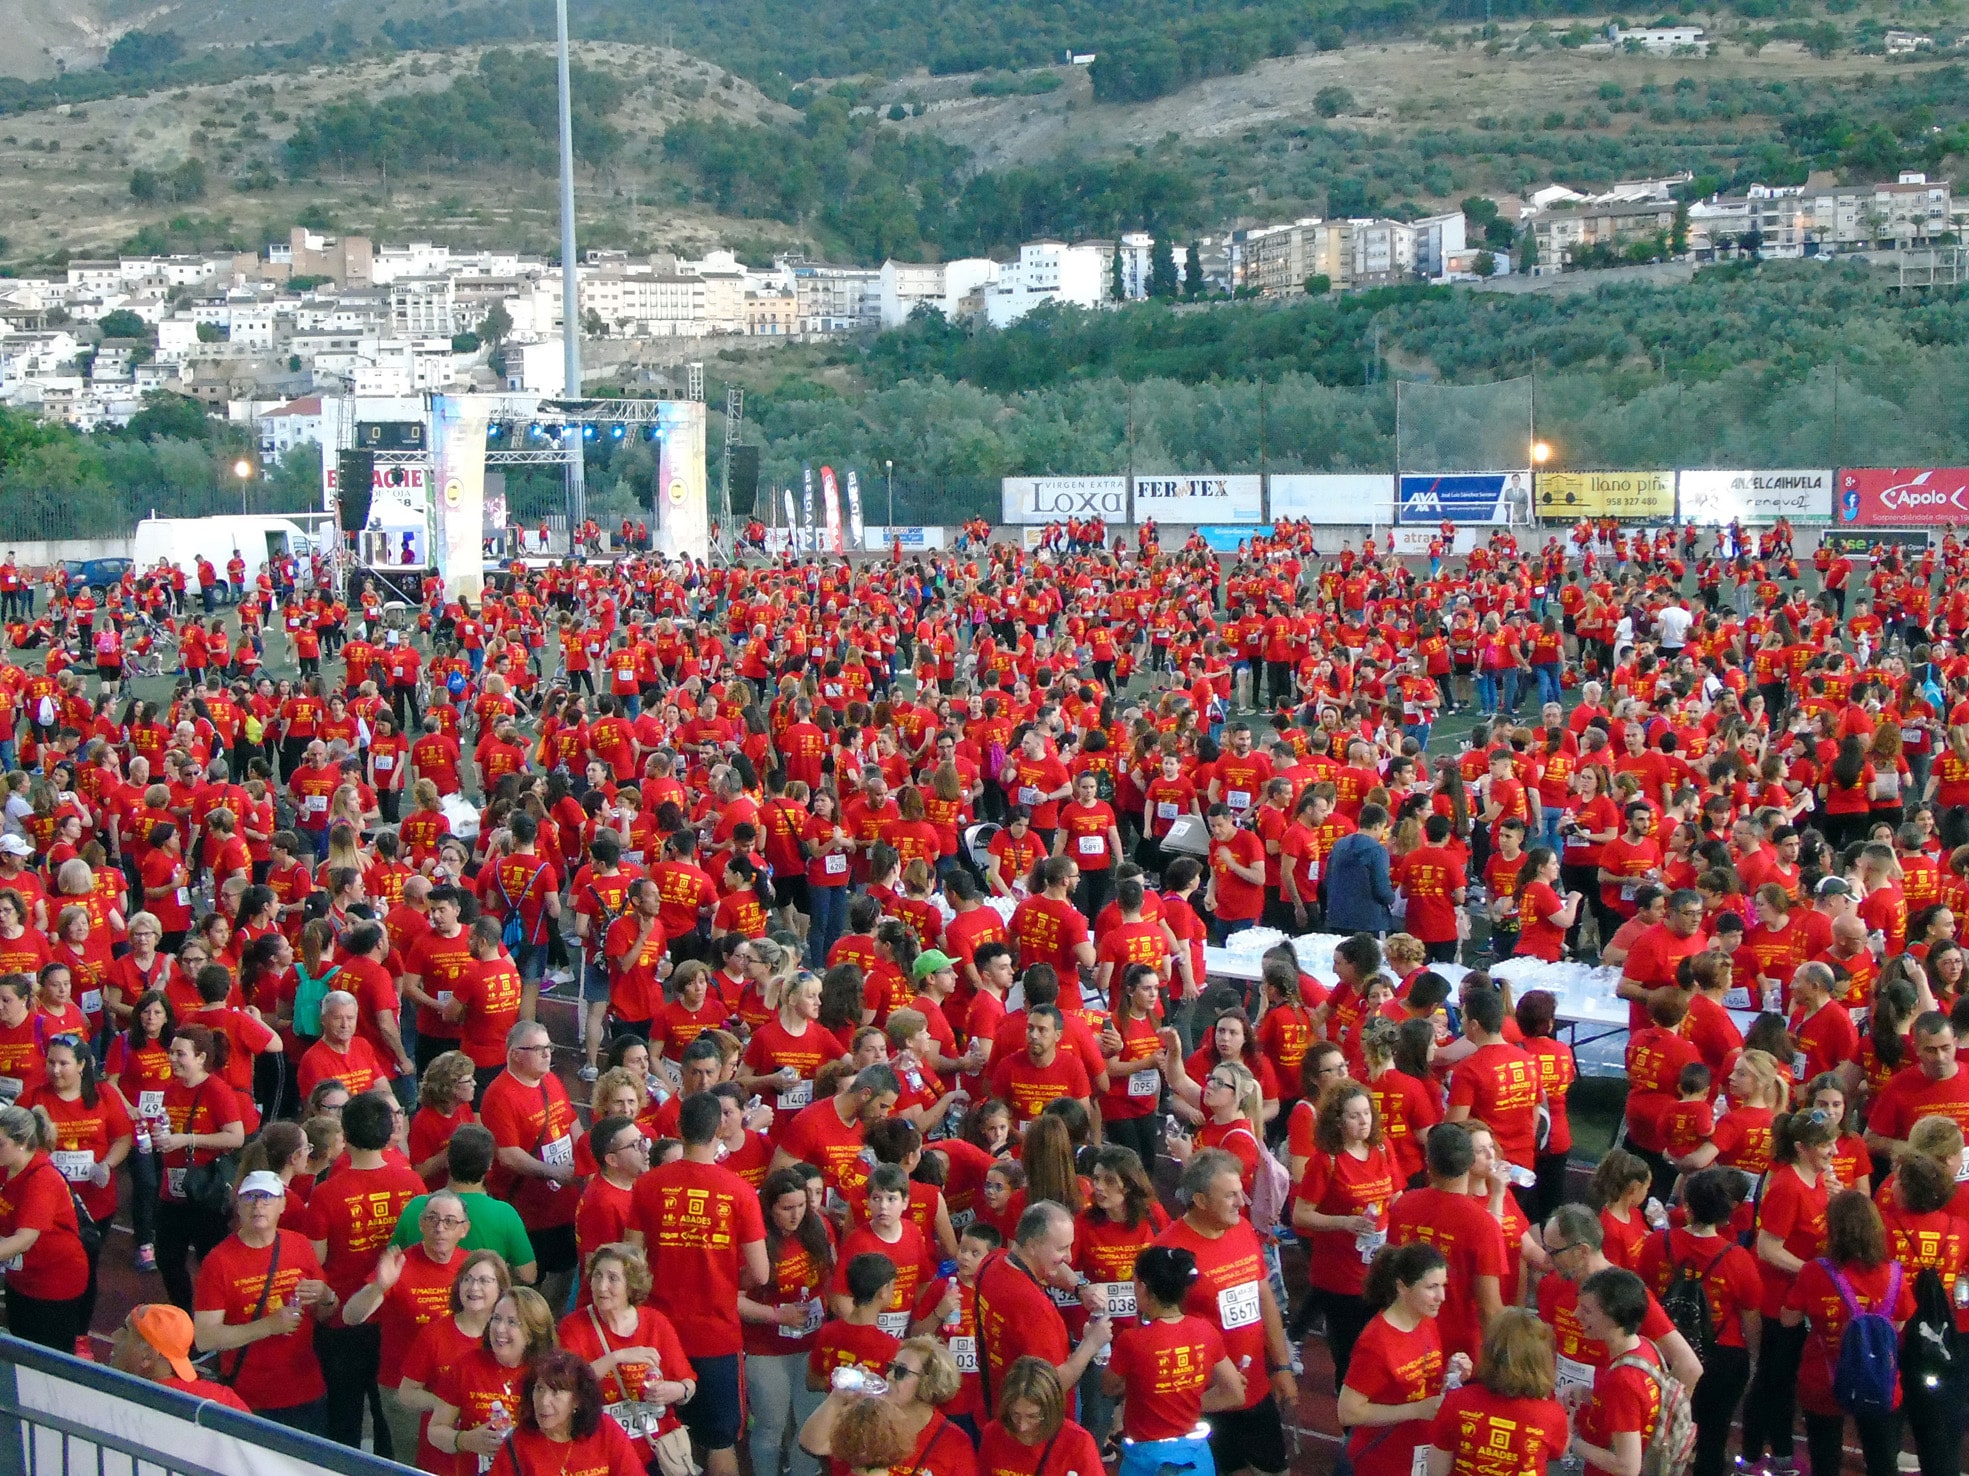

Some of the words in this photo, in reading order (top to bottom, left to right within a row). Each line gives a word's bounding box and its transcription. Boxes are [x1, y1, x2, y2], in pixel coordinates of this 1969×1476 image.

[1045, 481, 1085, 489] VIRGEN
[1591, 477, 1631, 491] llano
[1403, 492, 1442, 512] AXA
[1897, 490, 1946, 507] Apolo
[144, 1103, 159, 1114] 49
[367, 1215, 399, 1227] ABADES
[680, 1215, 712, 1225] ABADES
[1107, 1299, 1136, 1312] 038
[1228, 1302, 1258, 1322] 5671
[1172, 1365, 1195, 1375] ABADES
[1477, 1446, 1518, 1461] ABADES
